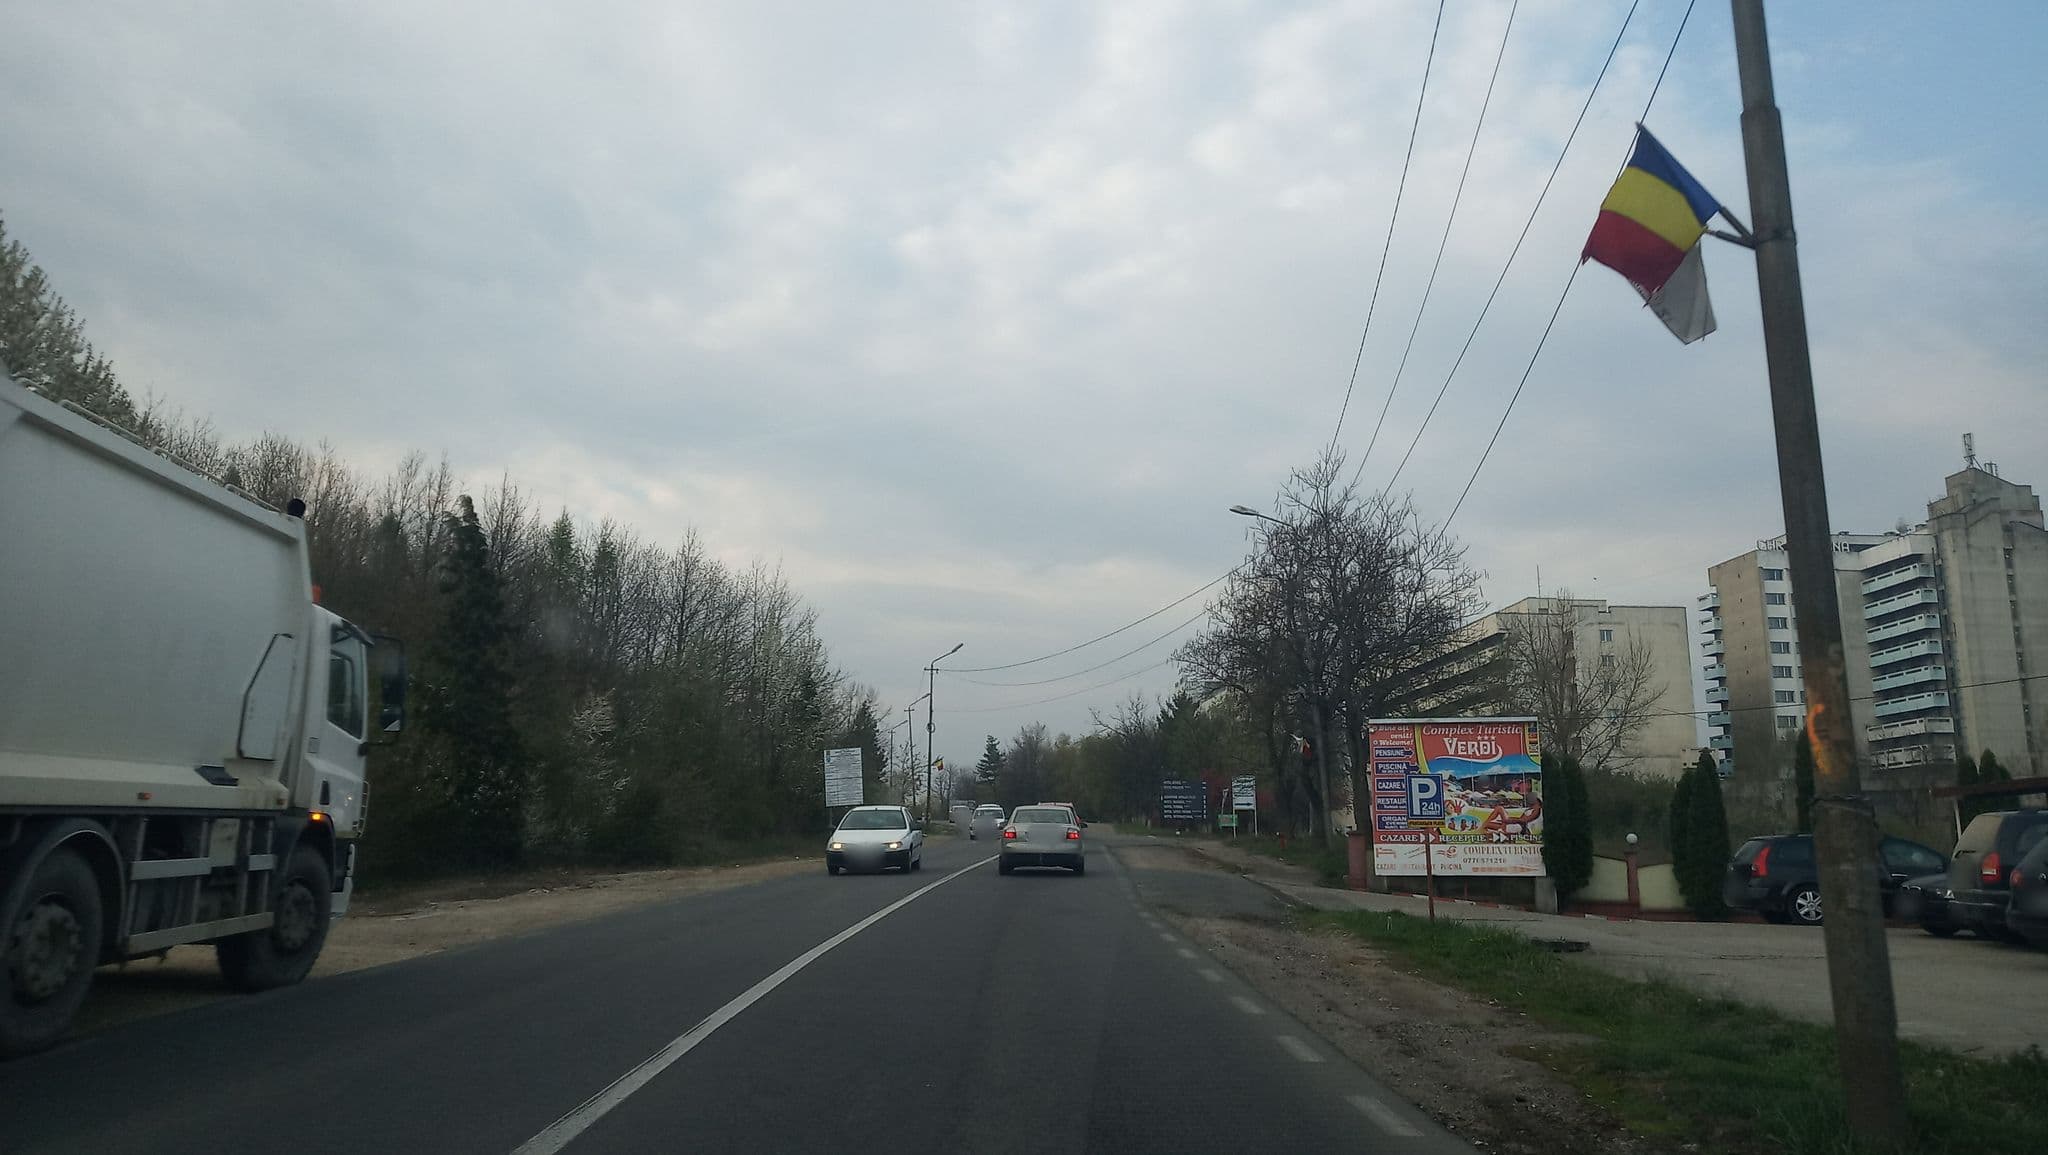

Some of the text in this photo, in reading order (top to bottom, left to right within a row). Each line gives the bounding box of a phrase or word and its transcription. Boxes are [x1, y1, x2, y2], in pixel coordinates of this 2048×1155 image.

[1423, 724, 1522, 737] Complex Turistic
[1443, 737, 1498, 756] VERDI
[1375, 749, 1404, 757] PENSIUNE
[1411, 778, 1437, 815] P
[1421, 801, 1440, 811] 24h
[1380, 834, 1418, 842] CAZARE
